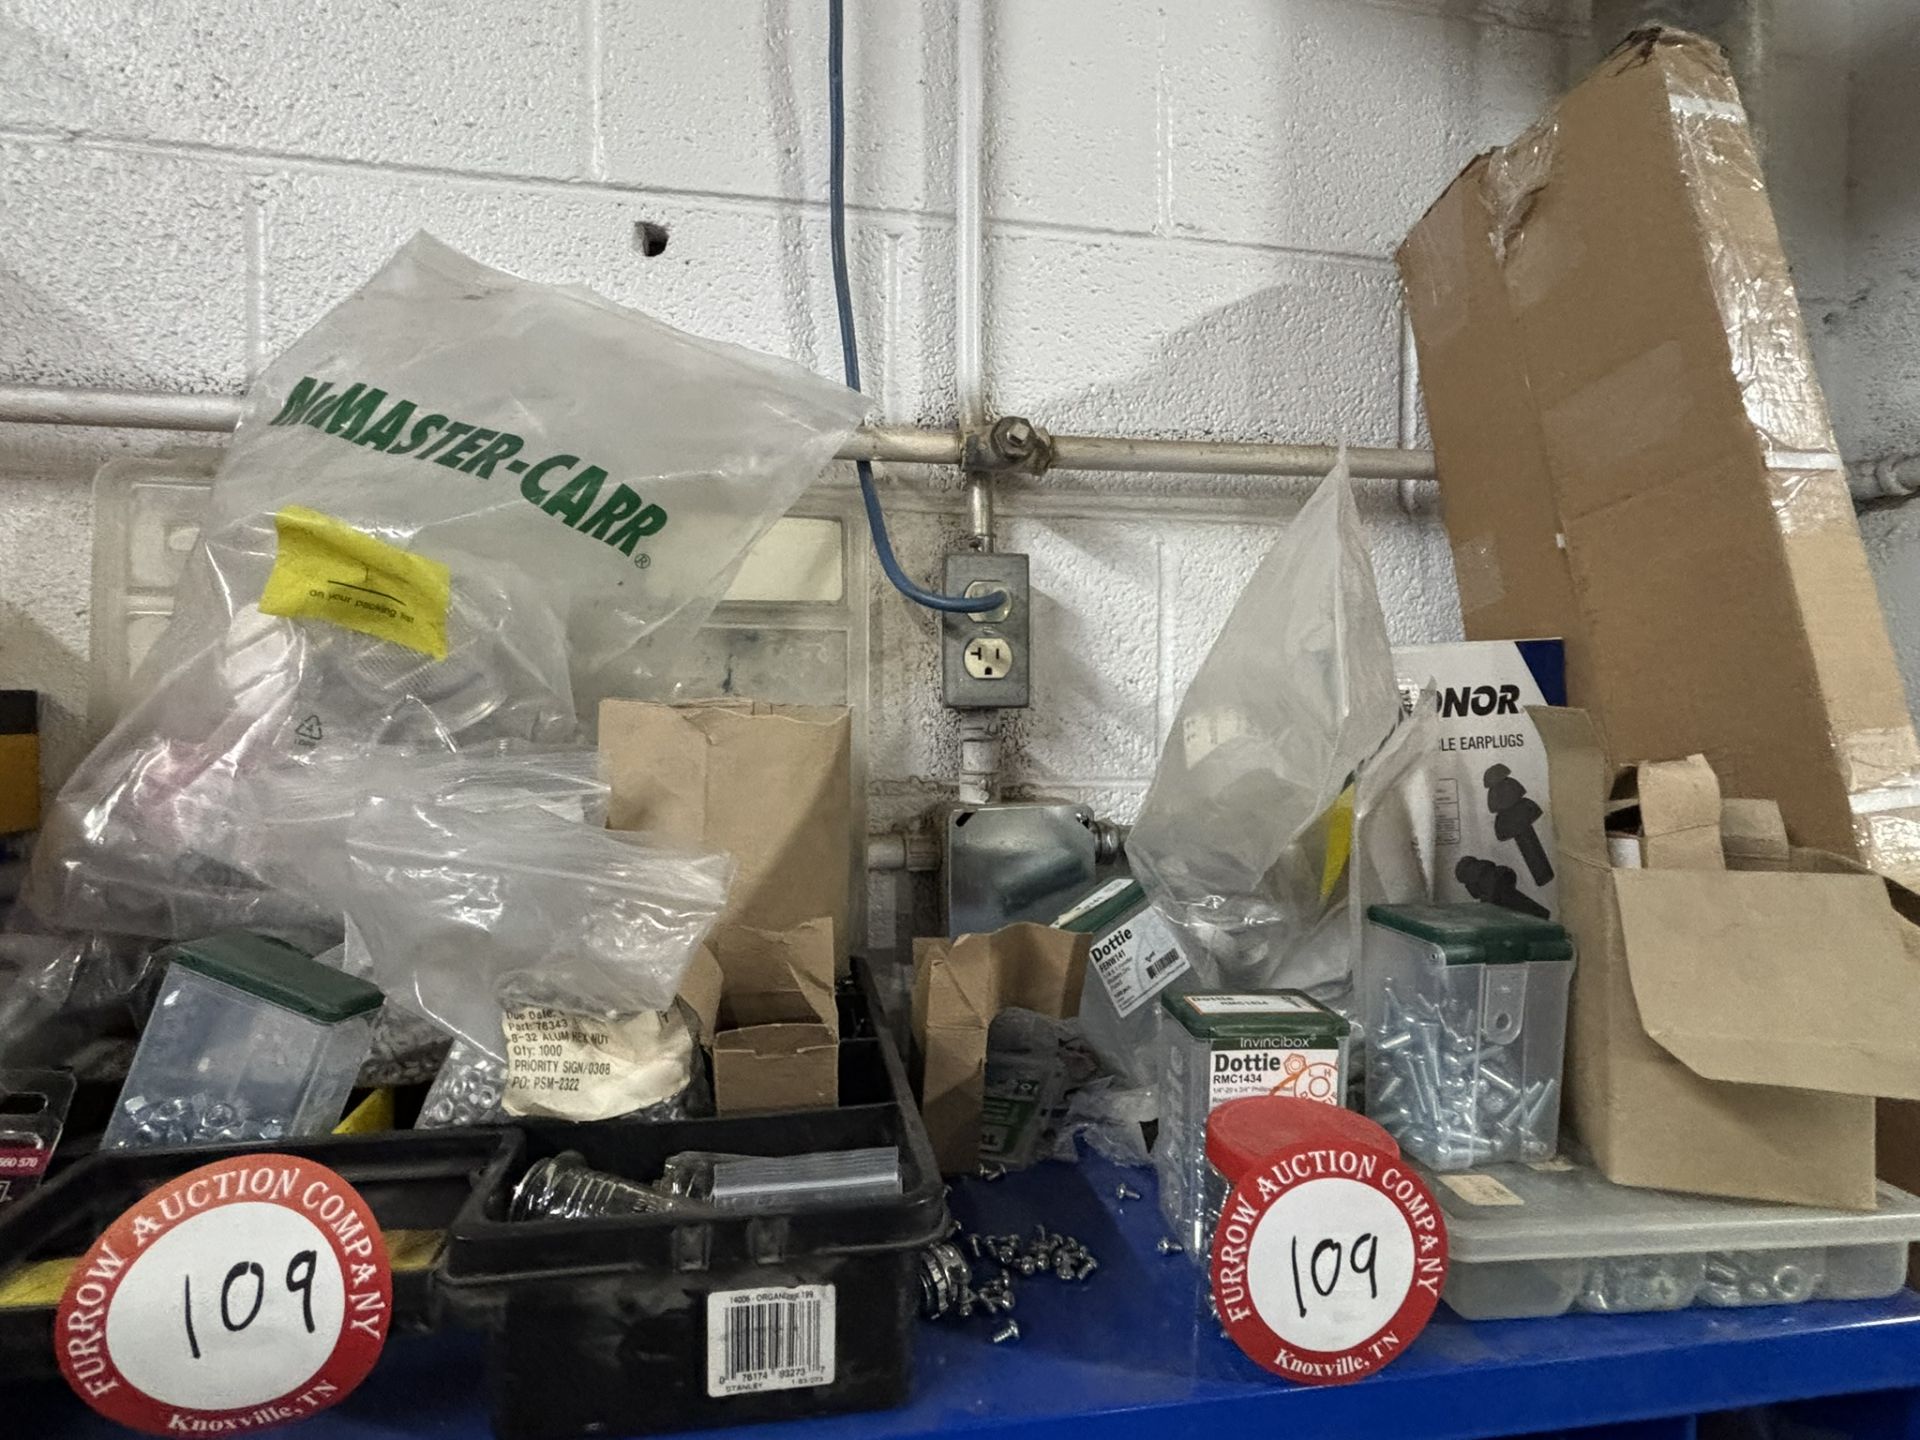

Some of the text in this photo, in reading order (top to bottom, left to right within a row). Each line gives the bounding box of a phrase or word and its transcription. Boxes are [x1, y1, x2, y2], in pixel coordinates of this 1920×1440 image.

[328, 592, 353, 604] your
[355, 599, 397, 618] packing
[1438, 734, 1524, 752] LE EARPLUGS
[1091, 928, 1133, 963] Dottie
[542, 1031, 570, 1042] ALUM
[539, 1045, 563, 1057] 1000
[1214, 1053, 1281, 1073] Dottie
[514, 1060, 559, 1074] PRIORITY
[1213, 1073, 1262, 1085] RMC1434
[511, 1076, 580, 1091] PO: PSM-2322
[1220, 1150, 1444, 1323] FURROW AUCTION COMPANY
[67, 1167, 385, 1397] FURROW AUCTION COMPANY
[1291, 1232, 1378, 1318] 109
[184, 1249, 317, 1360] 109
[1273, 1330, 1400, 1378] Knoxville, TN
[167, 1379, 338, 1432] Knoxville, TN
